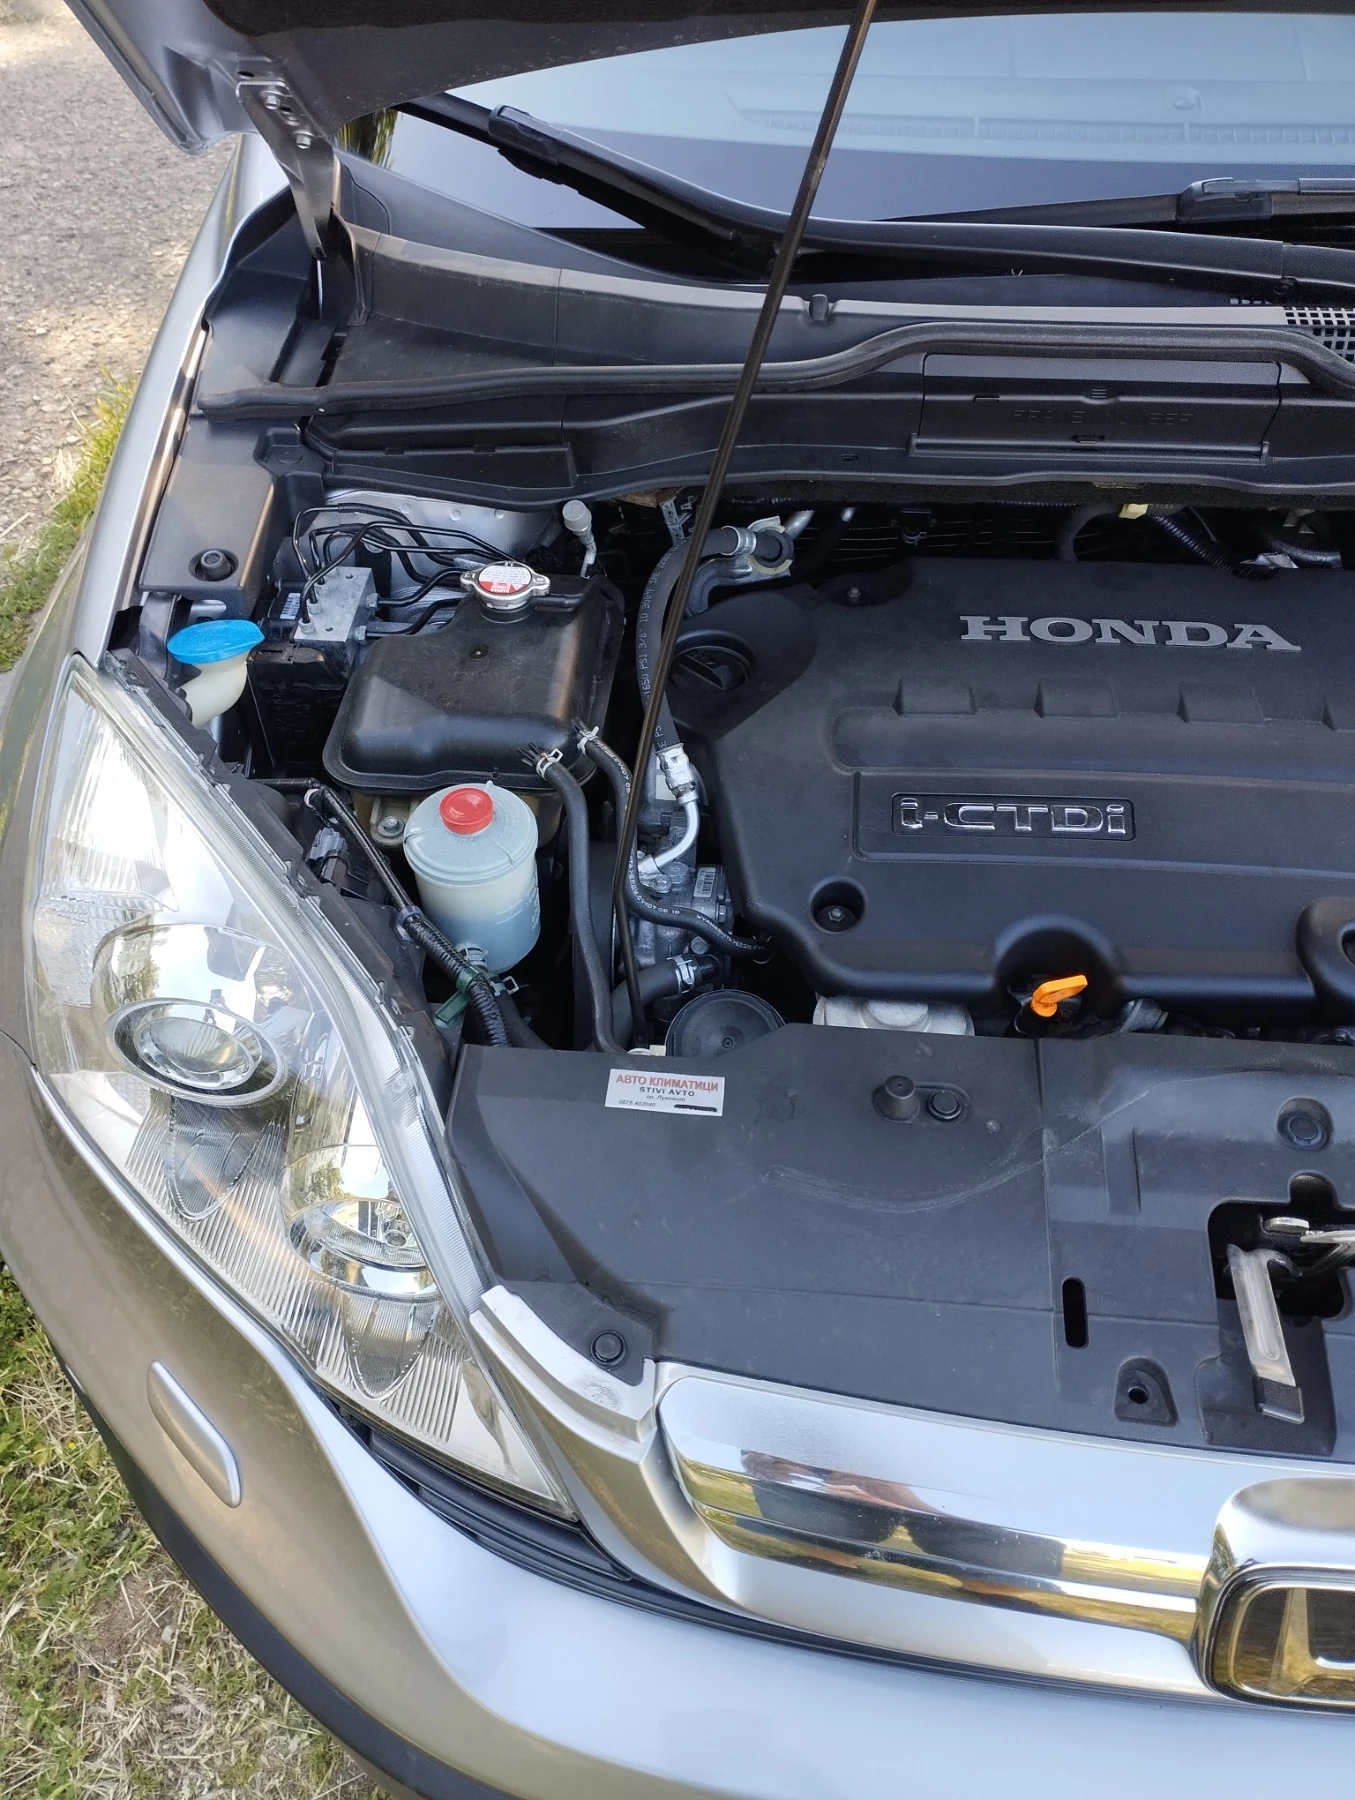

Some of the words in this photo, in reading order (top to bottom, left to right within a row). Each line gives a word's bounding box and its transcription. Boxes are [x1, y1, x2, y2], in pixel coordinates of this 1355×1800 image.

[959, 615, 1302, 652] HONDA
[639, 653, 648, 670] PSI
[901, 798, 1126, 835] i-CTDi
[616, 1074, 647, 1086] АВТО
[649, 1076, 719, 1093] КЛИМАТИЦИ
[639, 1086, 666, 1095] STIVI
[668, 1089, 695, 1097] AVTO
